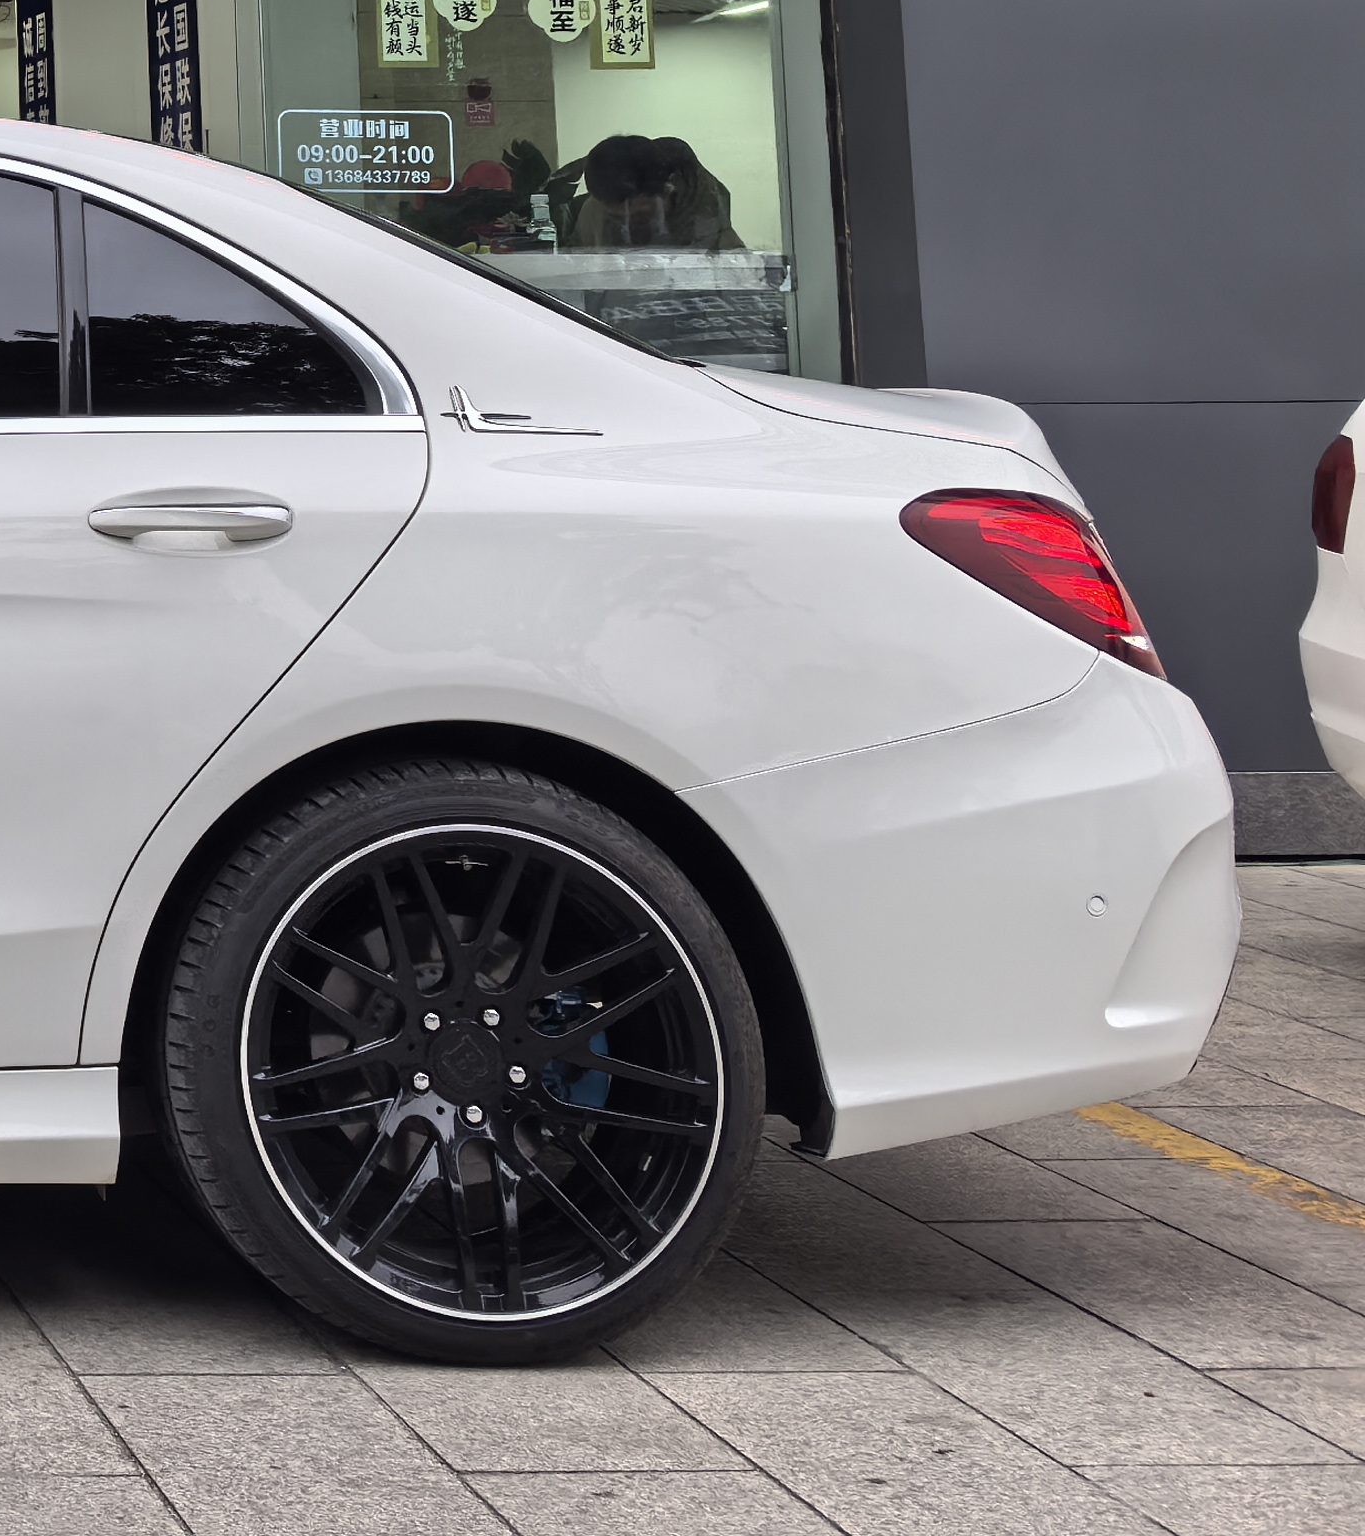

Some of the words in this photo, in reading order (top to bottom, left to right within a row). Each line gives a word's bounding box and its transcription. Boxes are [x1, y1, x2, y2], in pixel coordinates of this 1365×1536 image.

[319, 118, 410, 140] 营业时间
[324, 169, 431, 185] 13684337789
